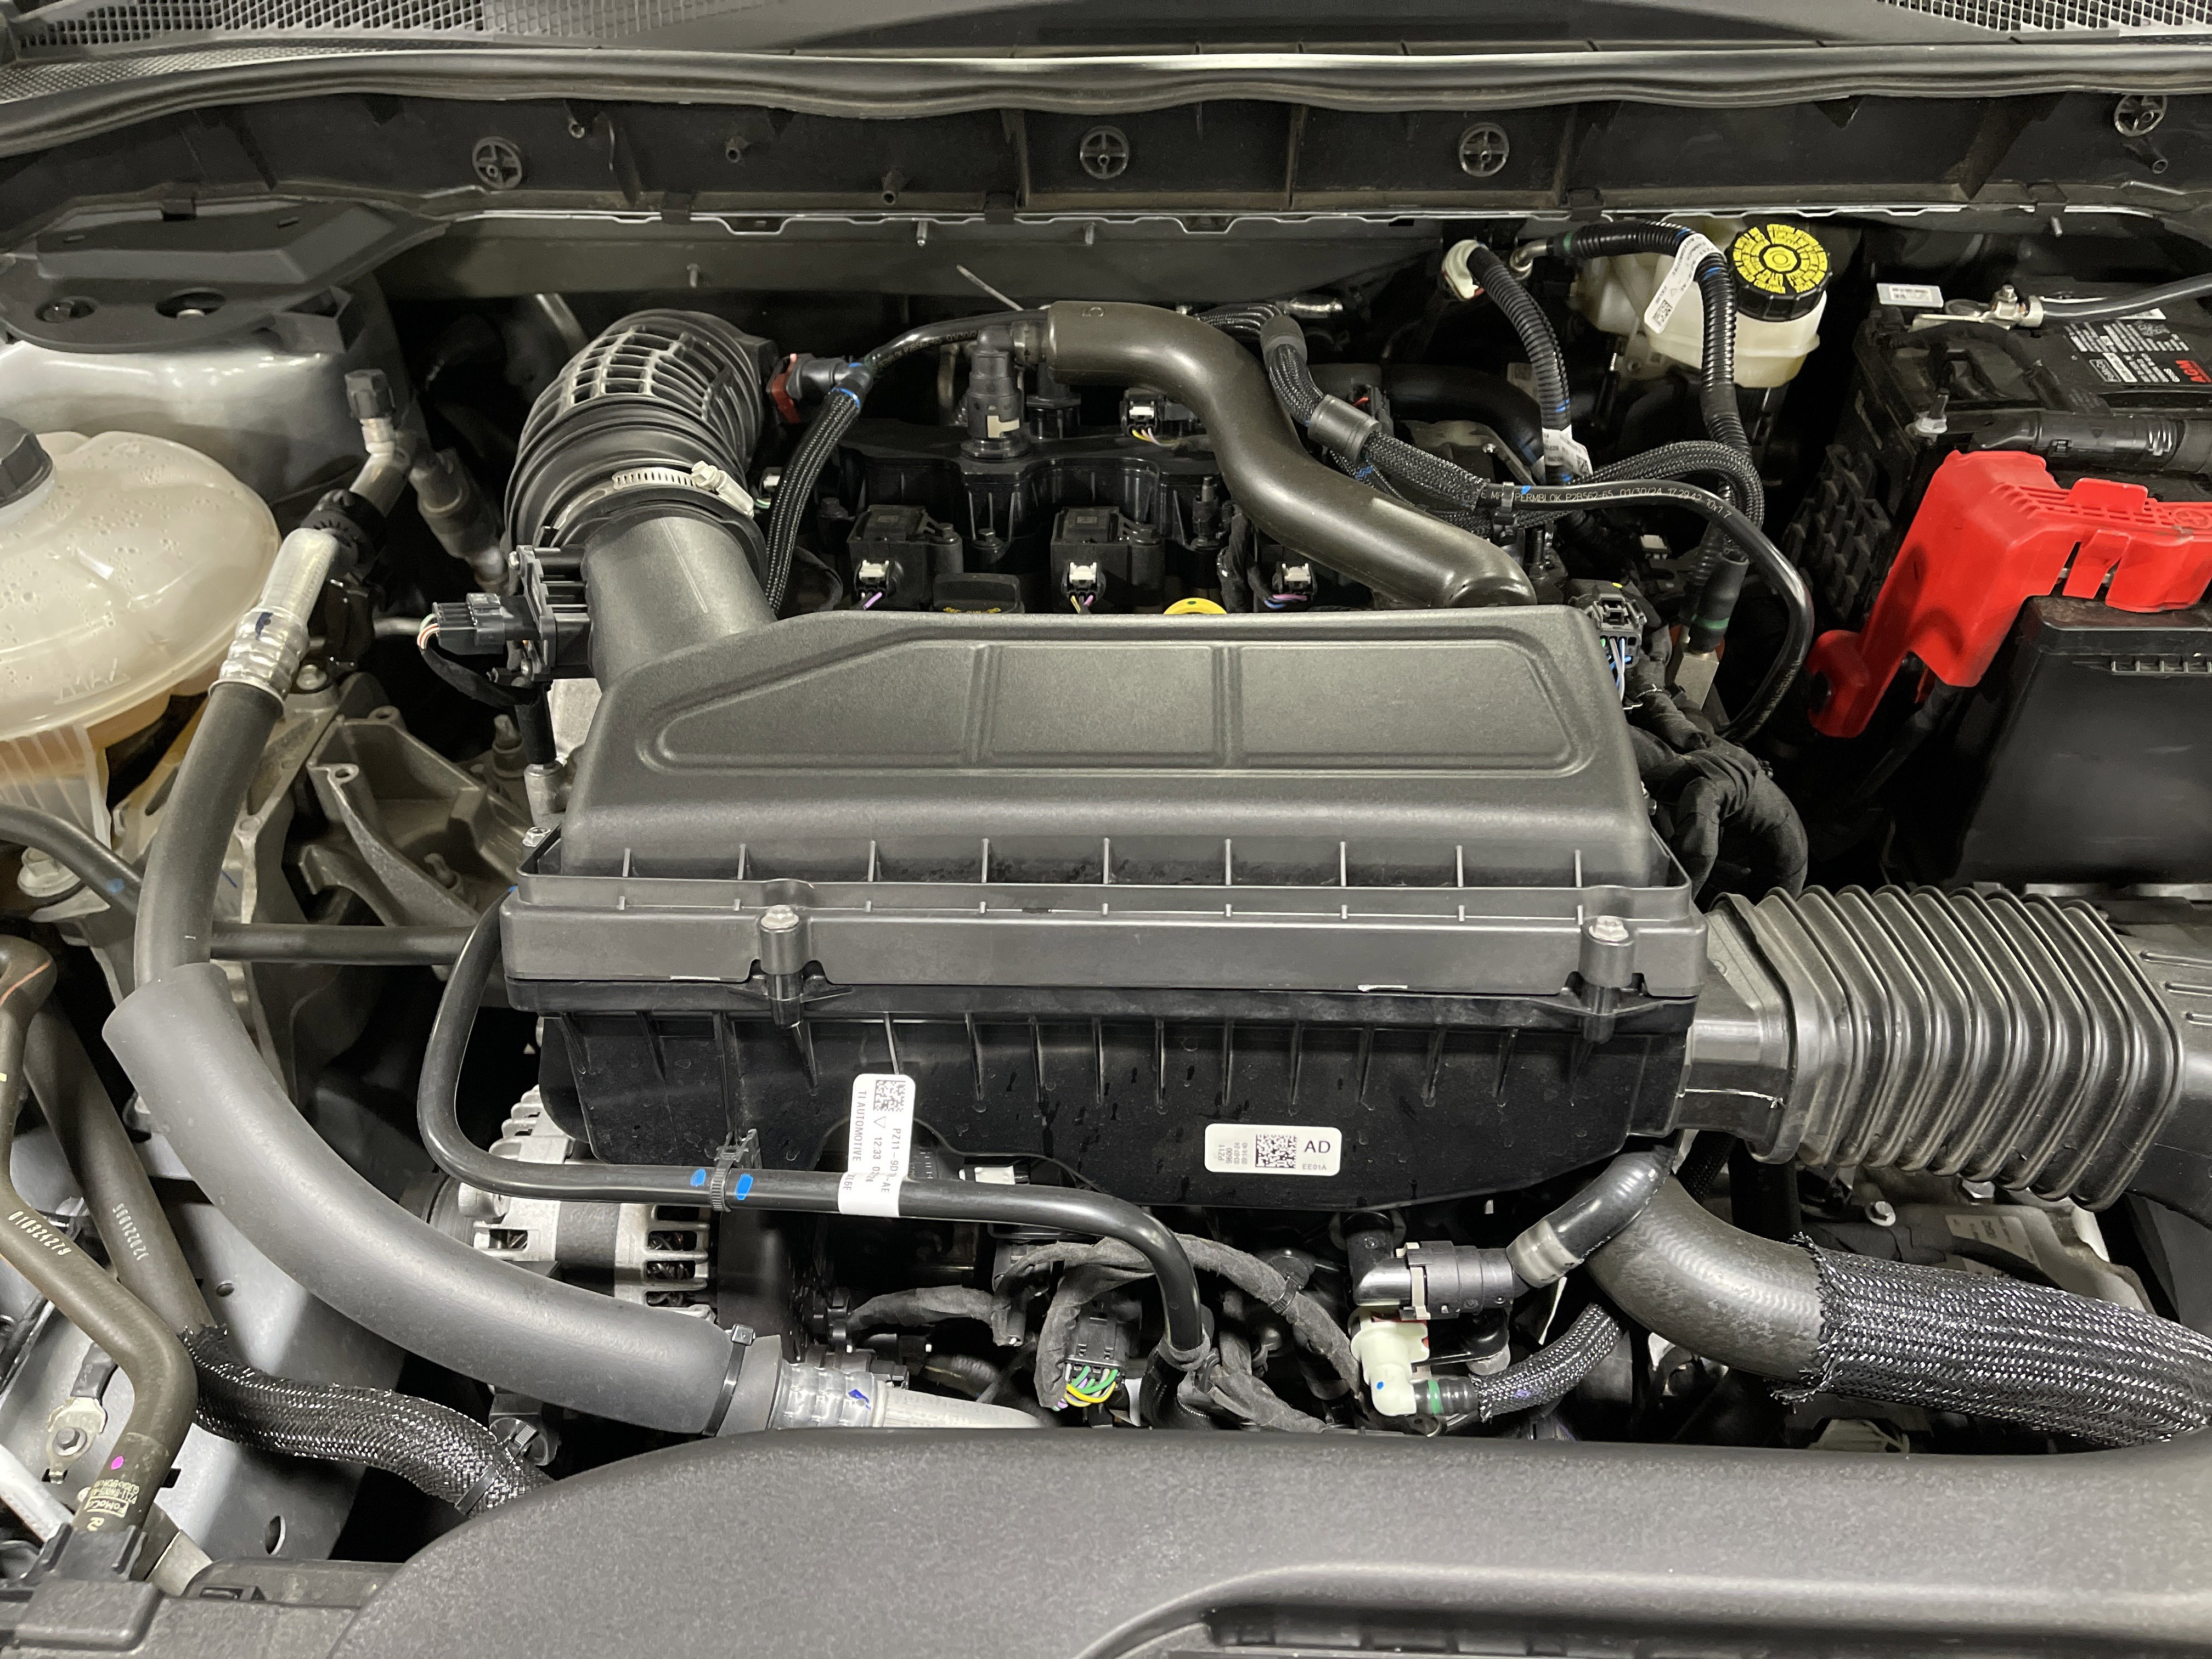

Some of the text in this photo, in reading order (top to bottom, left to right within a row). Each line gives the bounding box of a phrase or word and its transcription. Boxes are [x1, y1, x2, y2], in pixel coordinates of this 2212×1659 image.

[1620, 487, 1662, 497] 01/30/24
[857, 1091, 867, 1099] TI
[852, 1102, 866, 1161] AUTOMOTIVE
[873, 1137, 882, 1160] 12:33
[1304, 1140, 1331, 1153] AD
[8, 1211, 72, 1255] 010324279
